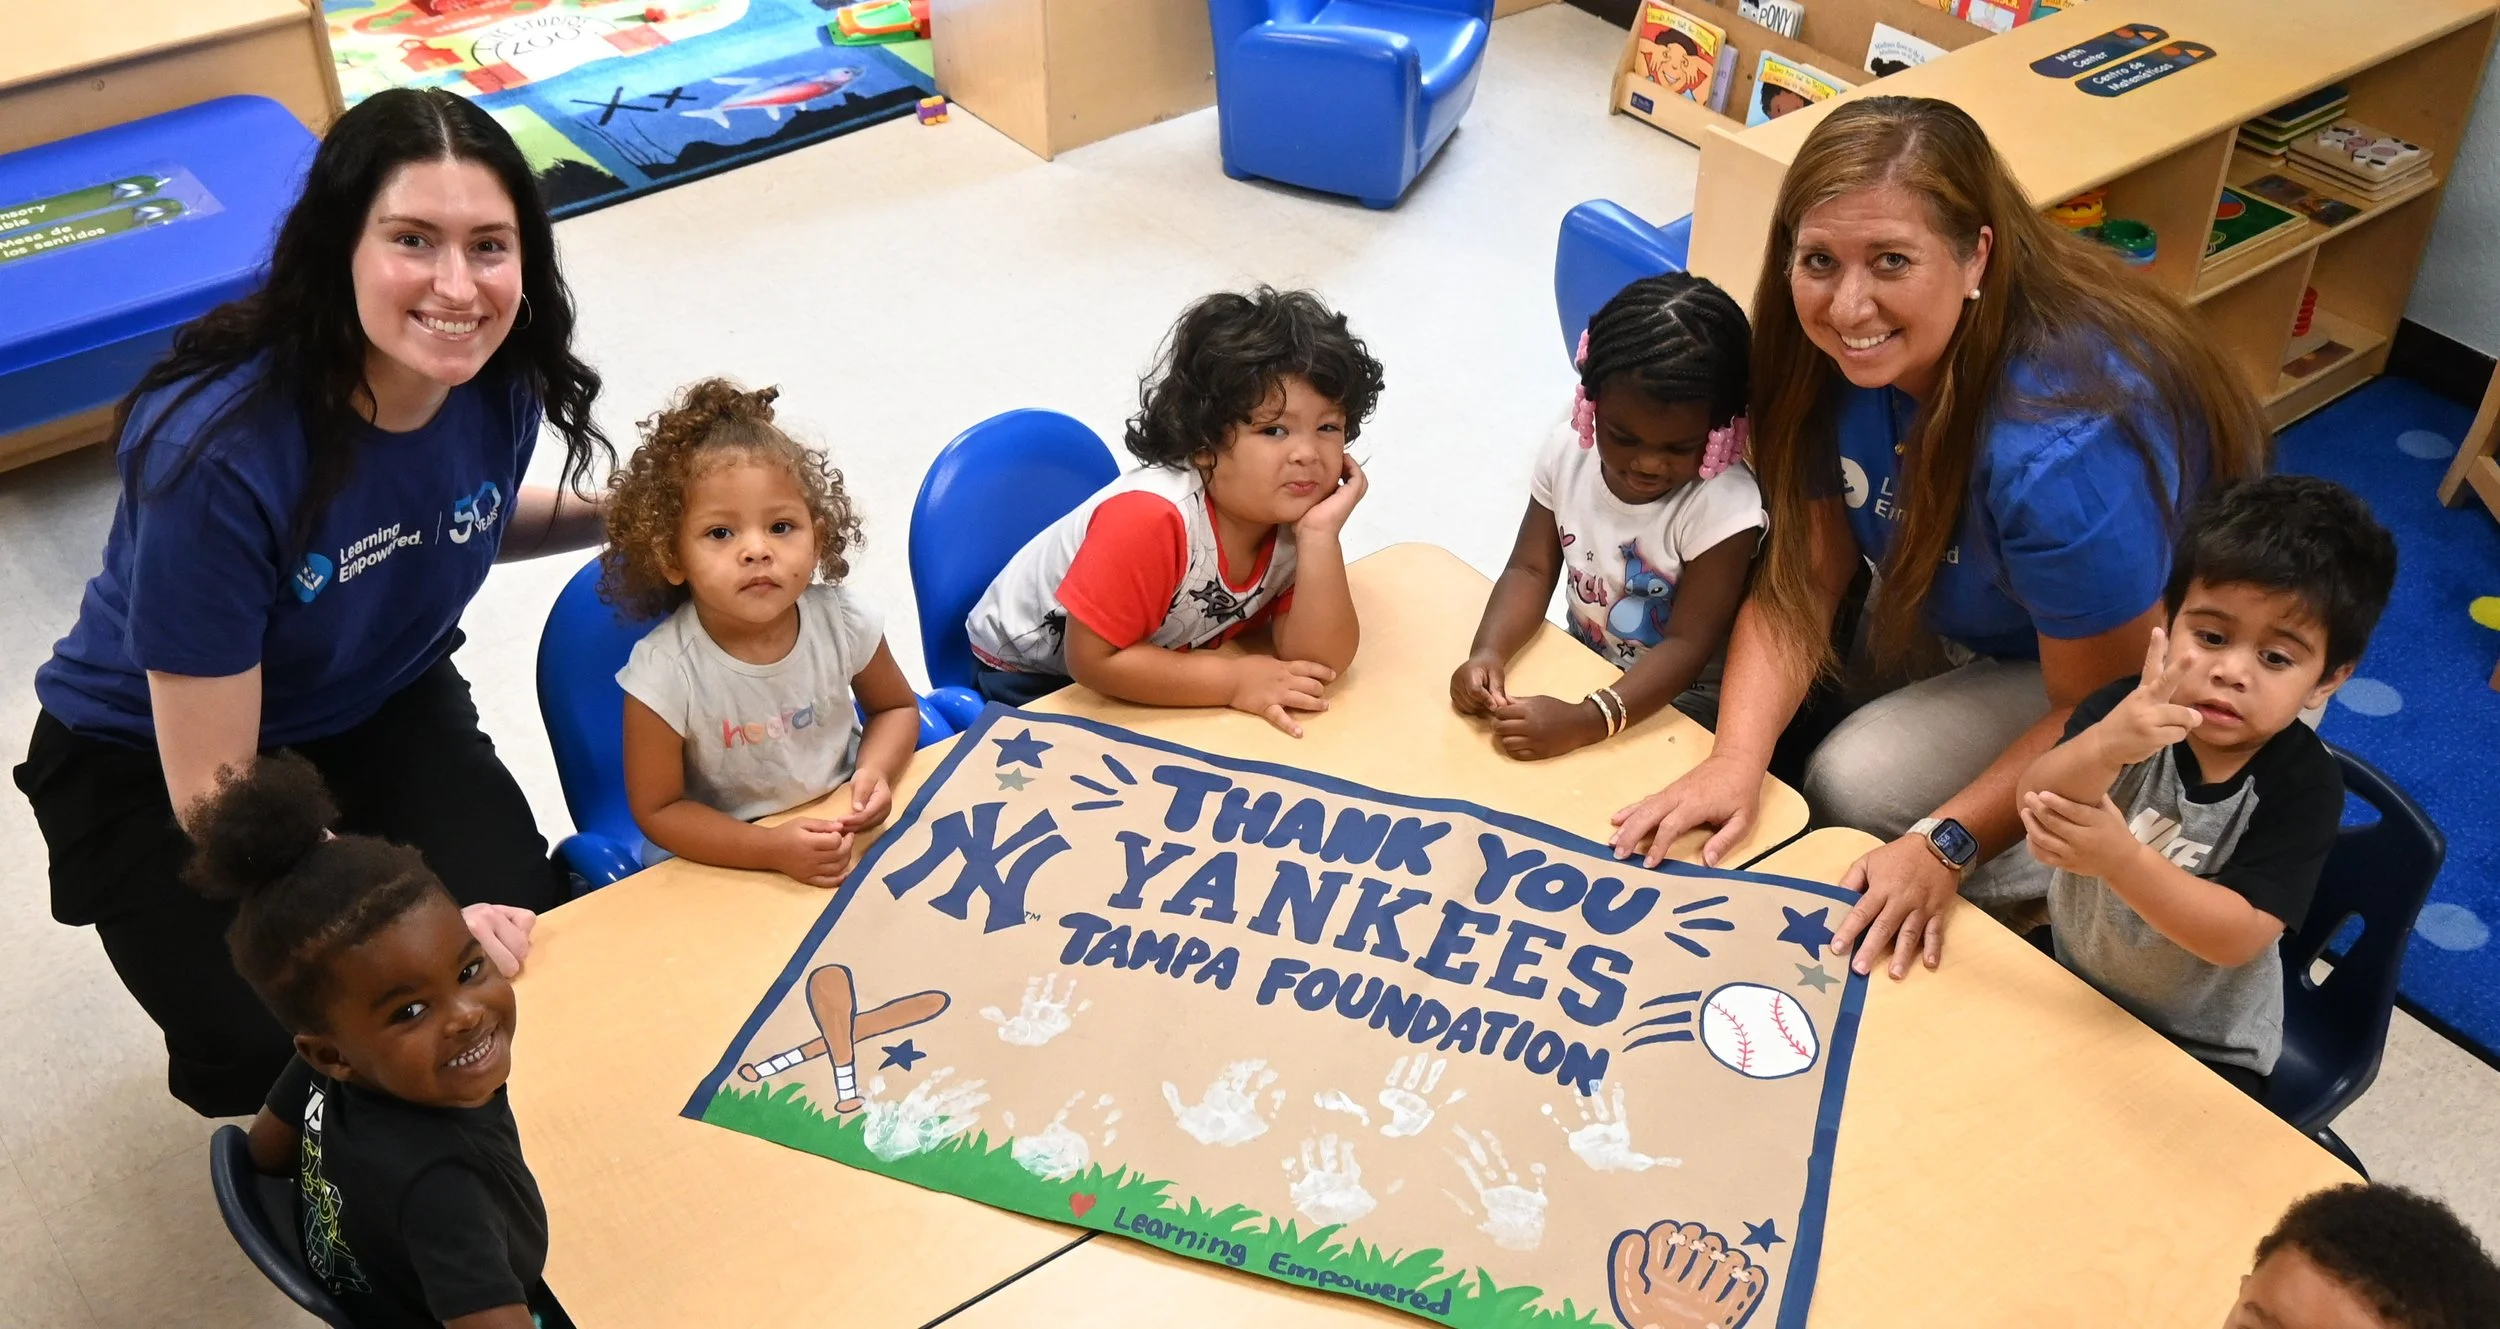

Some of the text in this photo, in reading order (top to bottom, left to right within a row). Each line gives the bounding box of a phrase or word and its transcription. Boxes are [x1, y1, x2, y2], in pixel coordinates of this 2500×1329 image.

[1759, 5, 1792, 36] PONY
[2055, 47, 2087, 63] Math
[2072, 51, 2108, 69] Center
[2092, 61, 2146, 85] Centro de
[0, 204, 47, 221] nsory
[0, 218, 30, 232] ble
[0, 226, 72, 250] Mesa de
[3, 227, 106, 258] los sentidos
[449, 481, 502, 544] 50
[475, 508, 499, 533] YEARS
[340, 523, 400, 565] Learning
[1152, 765, 1661, 935] THANK YOU
[882, 802, 1072, 934] NY
[1107, 831, 1633, 1027] YANKEES
[1059, 912, 1610, 1098] TAMPA FOUNDATION
[1114, 1206, 1452, 1316] Learning Empowered
